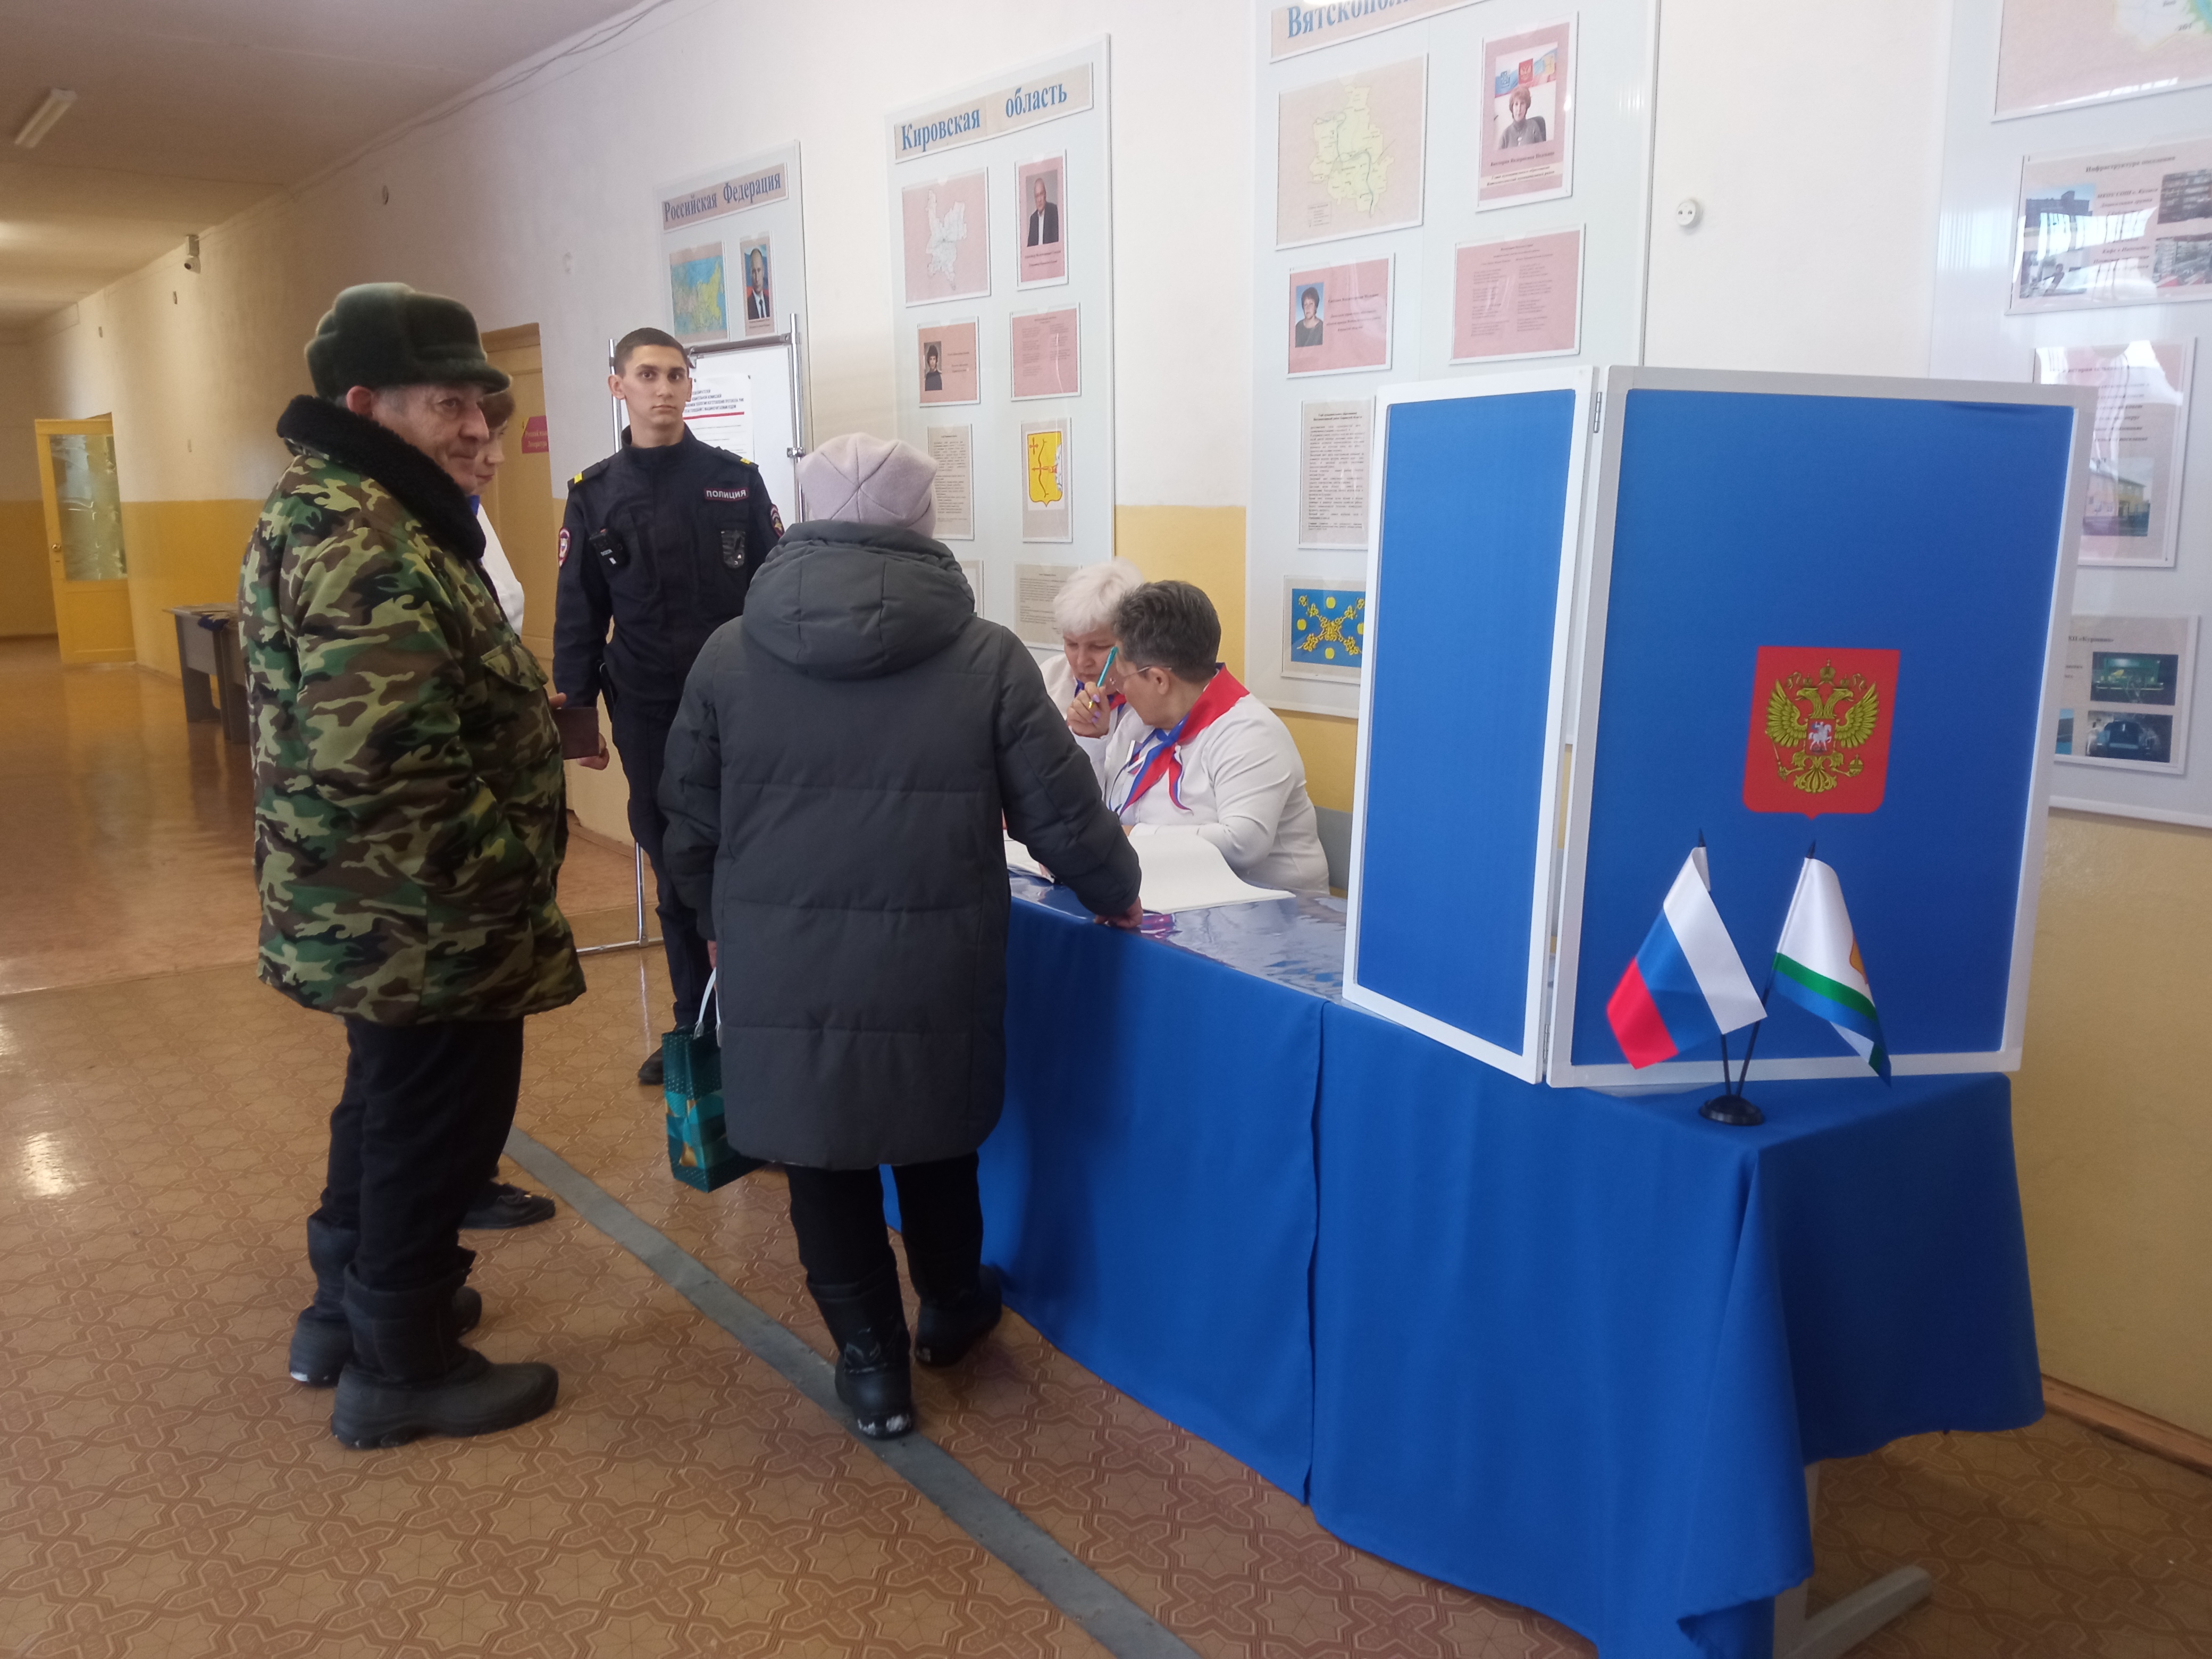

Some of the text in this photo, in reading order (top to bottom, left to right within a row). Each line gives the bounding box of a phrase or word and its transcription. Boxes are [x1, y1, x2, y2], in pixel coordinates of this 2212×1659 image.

[1287, 0, 1408, 38] Вятскоп
[902, 83, 1067, 152] Кировская область
[2085, 161, 2140, 172] Инфраструктура
[665, 173, 781, 222] Российская Федерация
[706, 490, 746, 499] ПОЛИЦИЯ
